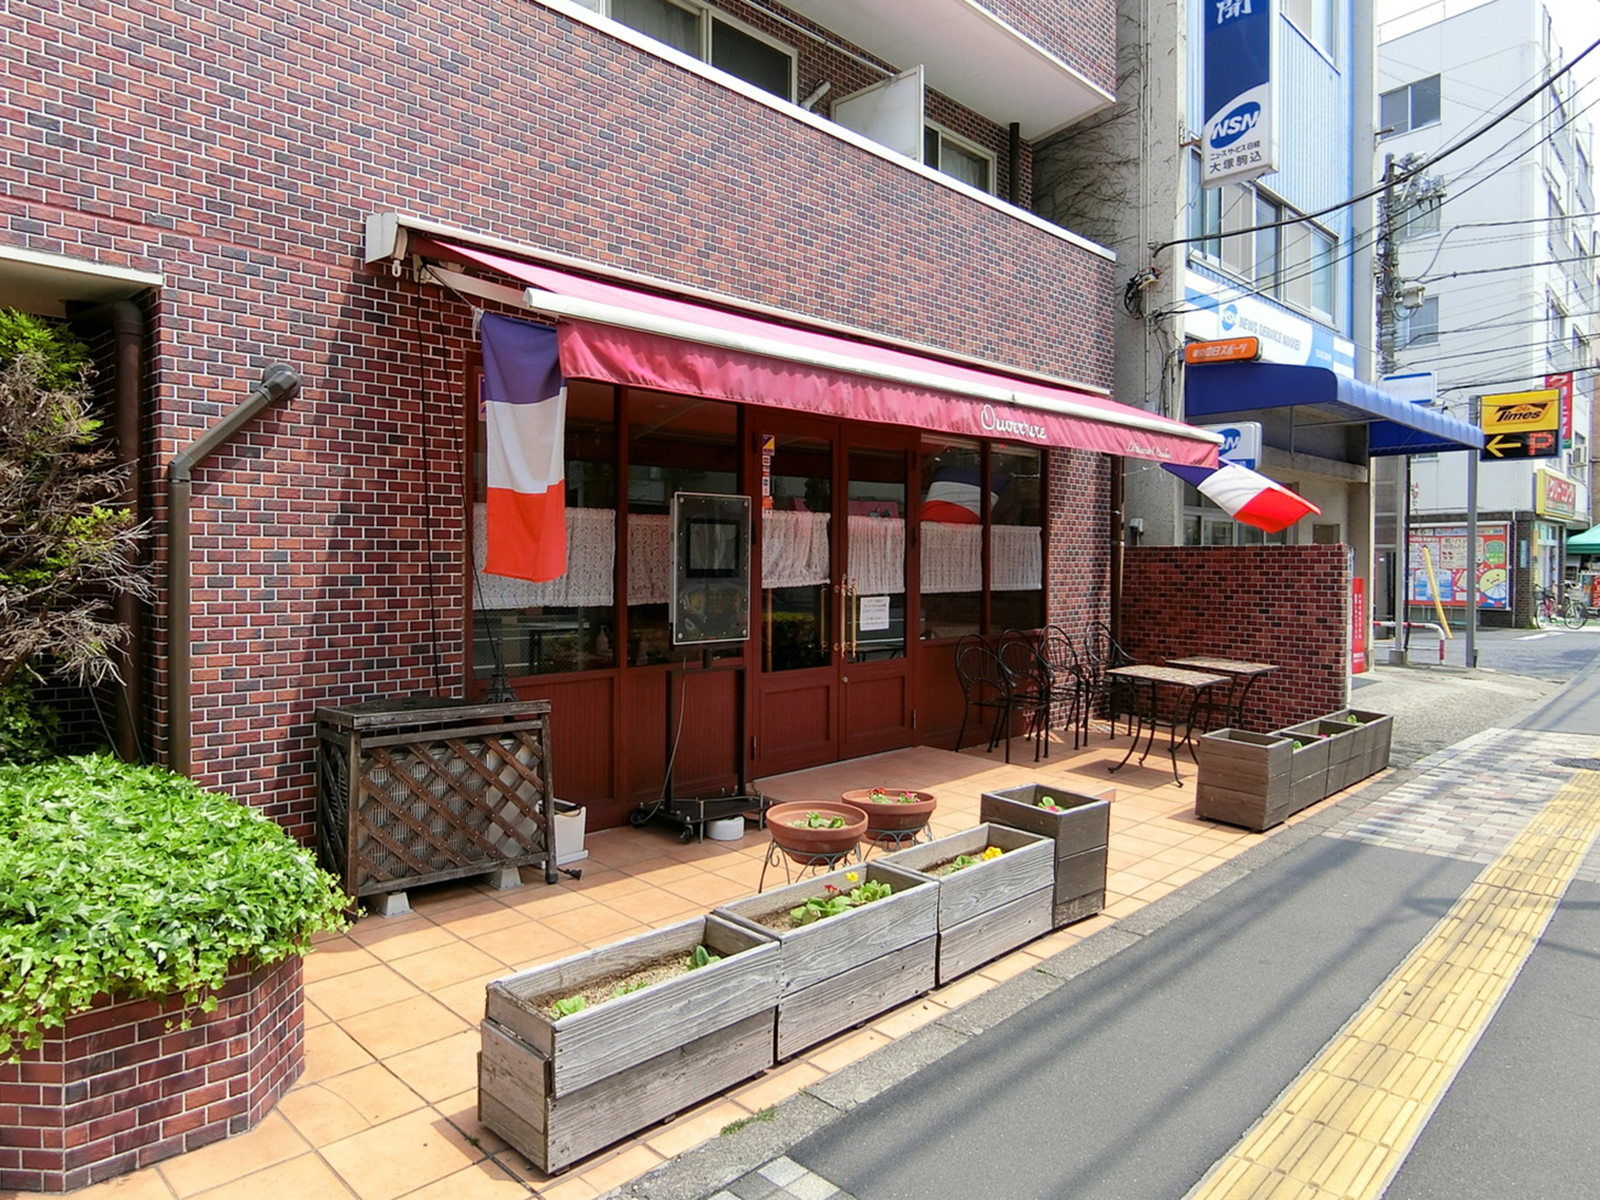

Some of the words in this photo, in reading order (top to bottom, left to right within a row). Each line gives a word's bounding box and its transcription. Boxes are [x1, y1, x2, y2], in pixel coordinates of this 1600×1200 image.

[1211, 110, 1260, 140] NSN
[1209, 151, 1262, 174] 大塚駒込
[1495, 402, 1549, 423] Times
[1528, 432, 1553, 455] P
